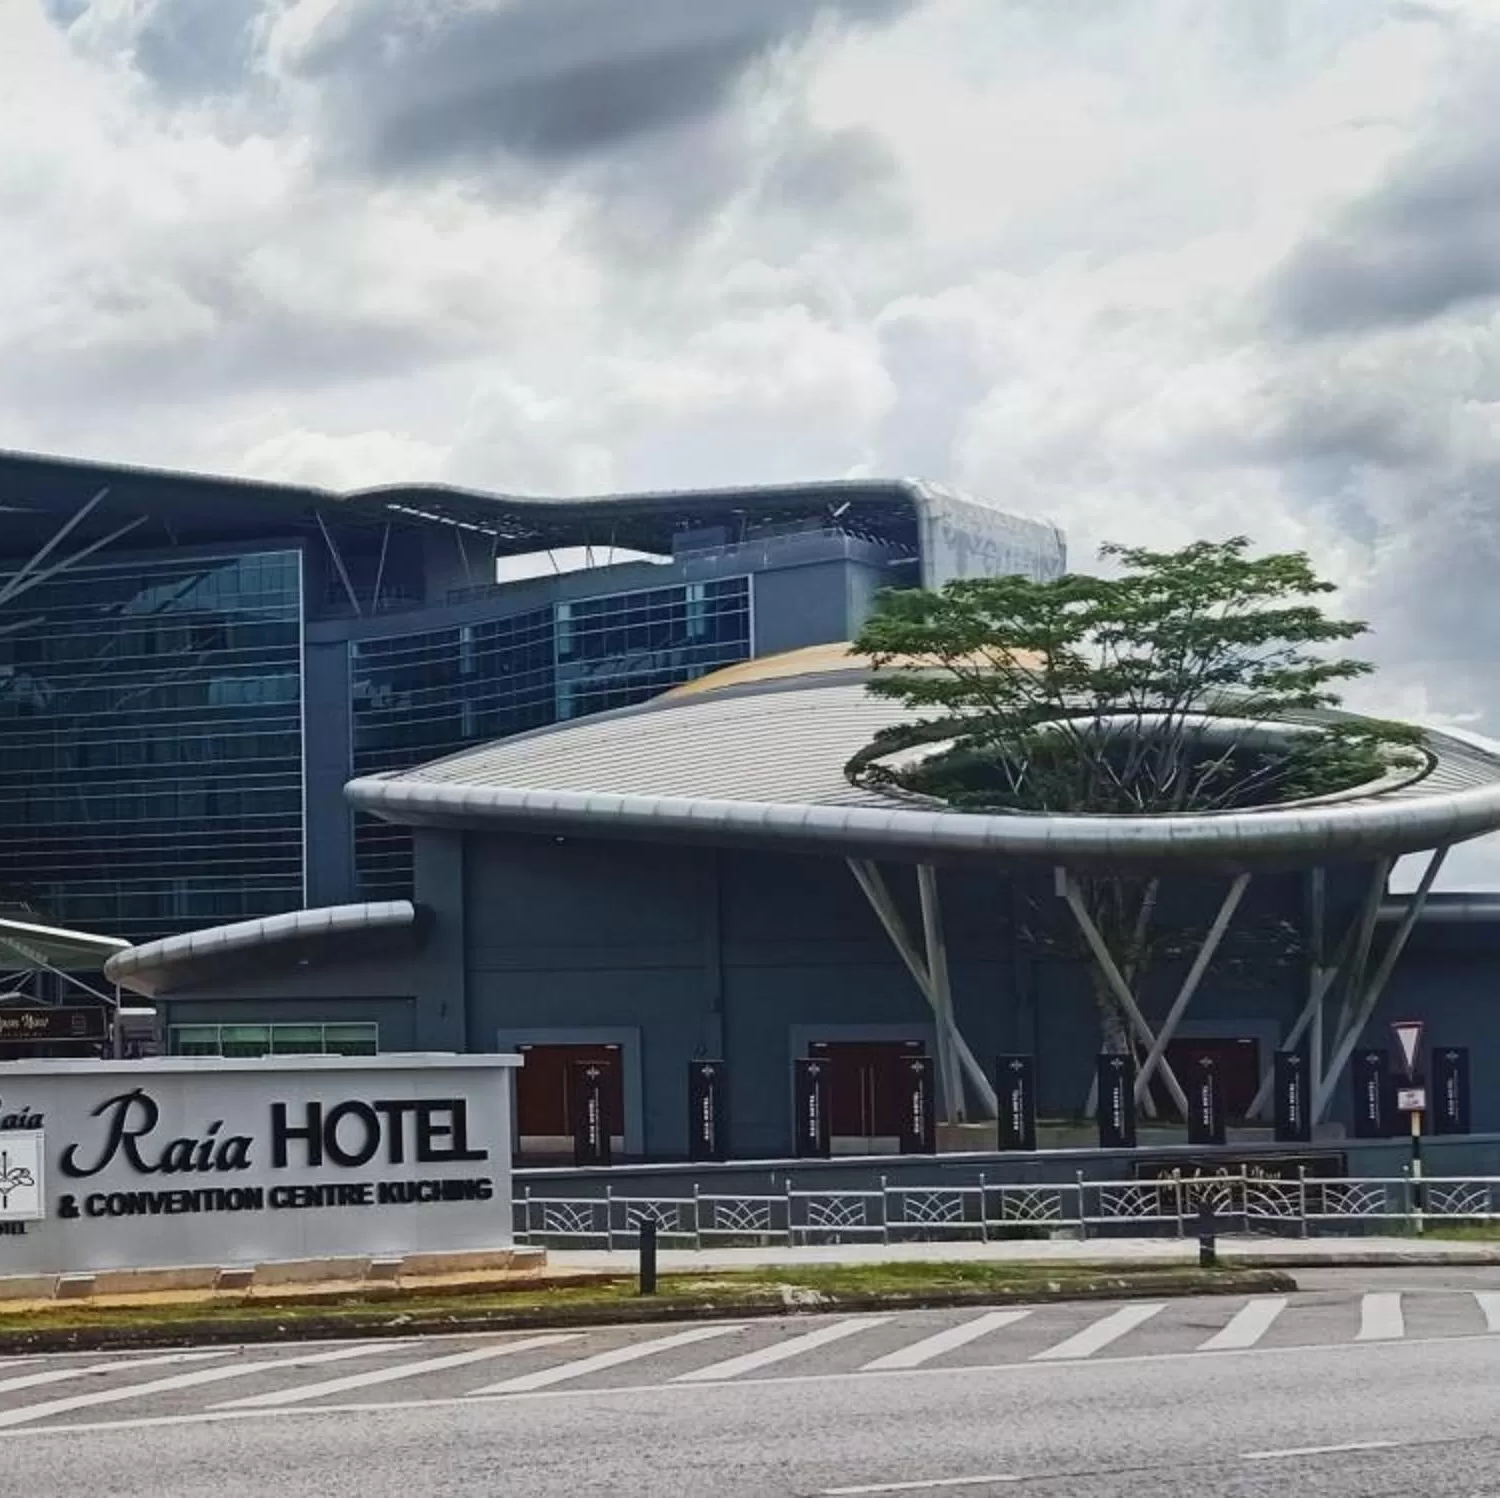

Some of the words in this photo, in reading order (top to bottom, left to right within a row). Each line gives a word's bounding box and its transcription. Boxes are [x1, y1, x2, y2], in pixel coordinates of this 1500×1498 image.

[60, 1087, 254, 1178] Raia
[269, 1098, 489, 1168] HOTEL
[57, 1194, 81, 1218] &
[85, 1186, 264, 1216] CONVENTION
[269, 1182, 375, 1209] CENTRE
[377, 1177, 494, 1204] KUCHING
